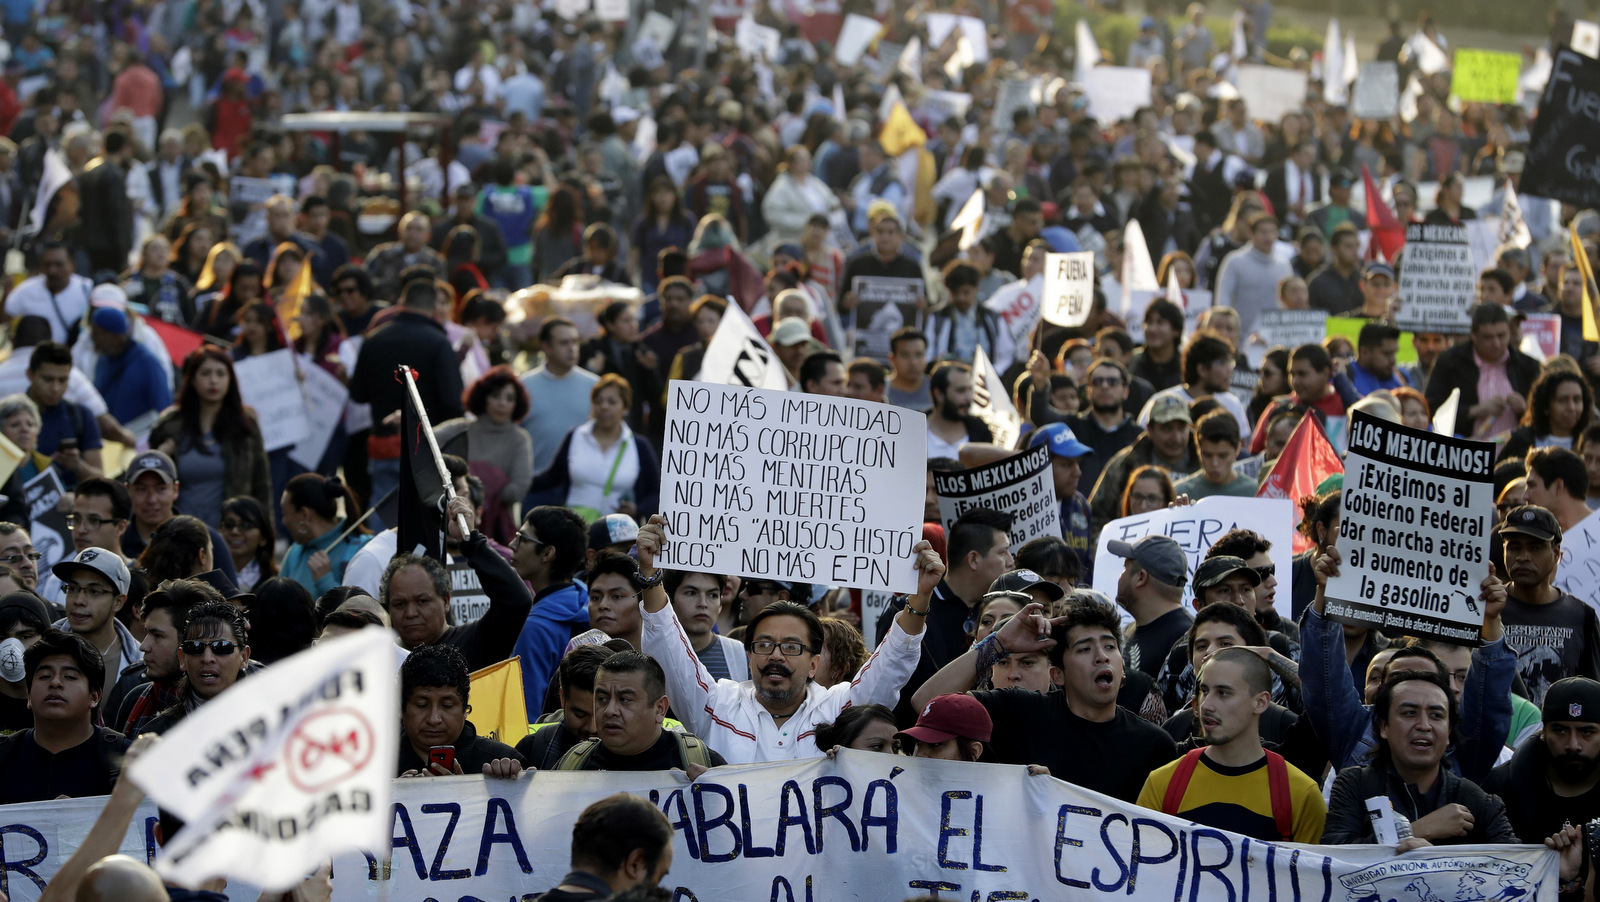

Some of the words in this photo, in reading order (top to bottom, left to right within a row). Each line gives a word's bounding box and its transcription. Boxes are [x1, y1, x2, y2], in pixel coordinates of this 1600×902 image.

[1058, 260, 1088, 281] FUERA
[677, 387, 711, 414] NO
[721, 389, 767, 420] MÁS
[781, 398, 902, 435] IMPUNIDAD
[670, 419, 700, 446] NO
[706, 421, 749, 453] MÁS
[757, 426, 896, 468] CORRUPCIÓN
[1351, 421, 1383, 452] ¡LOS
[1385, 430, 1491, 475] MEXICANOS!
[667, 449, 698, 476] NO
[702, 452, 746, 481] MÁS
[761, 459, 867, 494] MENTIRAS
[936, 475, 967, 494] ¡LOS
[970, 444, 1050, 491] MEXICANOS!
[1031, 475, 1043, 499] al
[1359, 462, 1446, 505] ¡Exigimos
[1453, 484, 1471, 508] al
[674, 480, 703, 508] NO
[712, 482, 754, 512] MÁS
[766, 489, 866, 524] MUERTES
[1012, 489, 1053, 526] Federal
[1030, 510, 1056, 537] atrás
[1344, 488, 1415, 525] Gobierno
[1421, 506, 1484, 538] Federal
[662, 511, 691, 538] NO
[699, 512, 740, 543] MÁS
[751, 518, 845, 551] "ABUSOS
[853, 525, 914, 560] HISTÓ
[1340, 516, 1366, 542] dar
[1372, 526, 1434, 554] marcha
[1440, 538, 1483, 564] atrás
[741, 547, 769, 575] NO
[777, 548, 816, 579] MÁS
[832, 555, 890, 587] EPN
[1350, 546, 1365, 569] al
[1371, 551, 1443, 583] aumento
[1449, 564, 1469, 588] de
[866, 592, 886, 609] dar
[1360, 575, 1375, 600] la
[1380, 579, 1451, 614] gasolina
[1324, 602, 1345, 617] ¡Basta
[1344, 606, 1352, 617] de
[1353, 609, 1385, 624] aumentos!
[1384, 613, 1404, 628] ¡Basta
[1404, 616, 1413, 629] de
[1413, 618, 1435, 633] afectar
[1434, 622, 1441, 635] al
[1440, 625, 1479, 641] consumidor!
[649, 765, 905, 863] ABLARÁ
[937, 790, 1008, 873] EL
[1344, 866, 1387, 888] UNIVERSIDAD
[1390, 860, 1429, 874] NACIONAL
[1431, 857, 1476, 871] AUTÓNOMA
[1478, 861, 1488, 870] DE
[1491, 860, 1527, 875] MÉXICO
